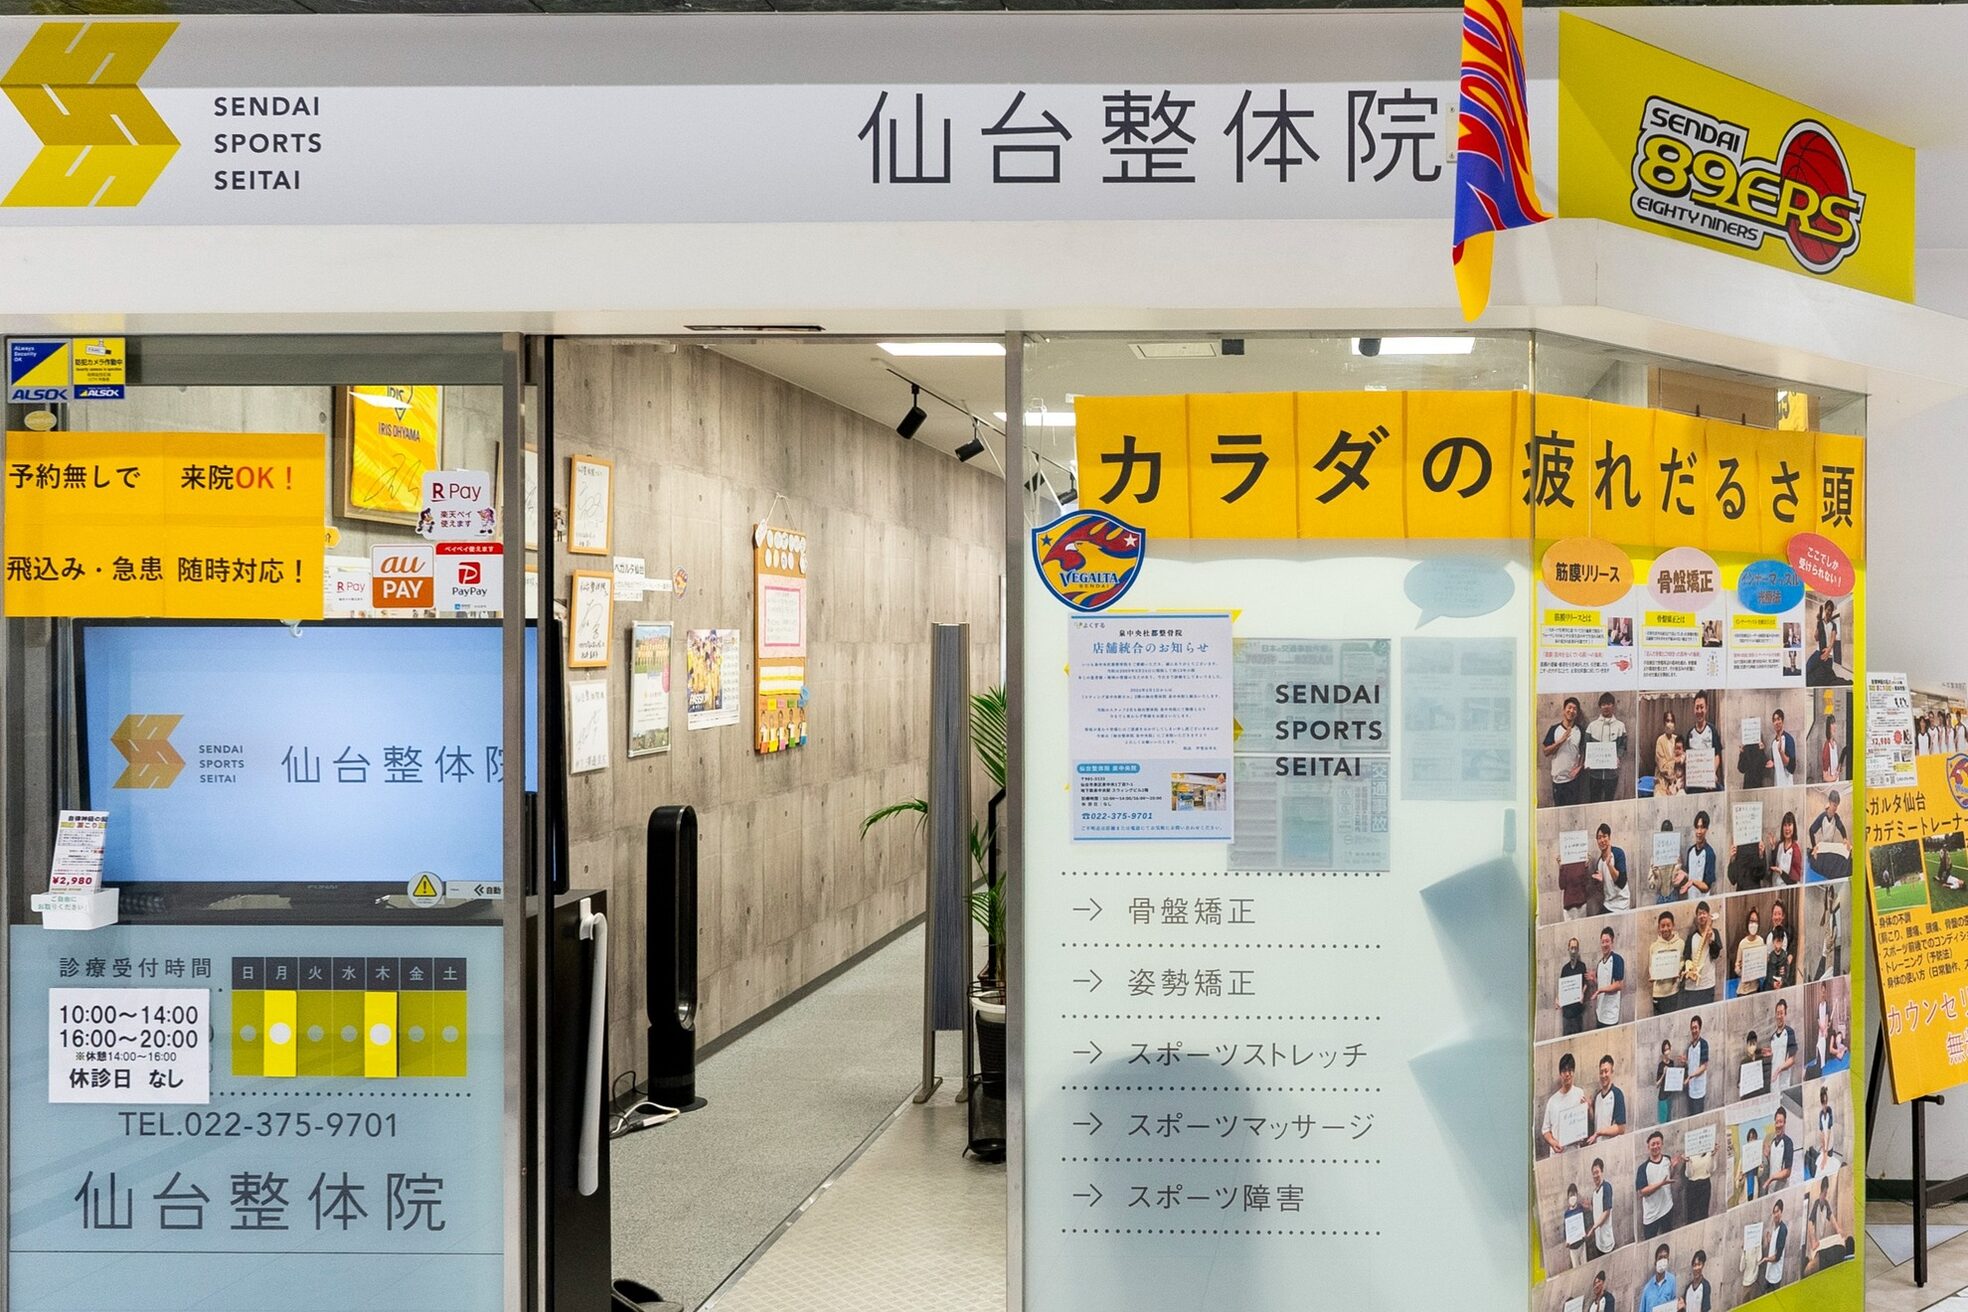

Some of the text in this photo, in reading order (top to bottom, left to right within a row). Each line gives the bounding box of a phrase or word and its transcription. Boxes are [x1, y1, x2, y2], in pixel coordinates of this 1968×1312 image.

[213, 96, 321, 117] SENDAI
[858, 90, 1443, 184] 仙台整体院
[1650, 107, 1741, 153] SENDAI
[213, 133, 323, 154] SPORTS
[213, 170, 301, 191] SEITAI
[1639, 135, 1861, 248] 89ERS
[1637, 196, 1760, 242] EIGHTY NINERS
[12, 388, 68, 401] ALSOK
[87, 389, 120, 397] ALSOK
[378, 422, 421, 442] IRIS OHYAMA
[9, 463, 141, 489] 予約無しで
[1100, 424, 1855, 528] カラダの疲れだるさ頭
[431, 482, 482, 502] R Pay
[440, 510, 472, 518] 楽天ペイ
[440, 519, 472, 528] 使えます
[380, 555, 426, 575] au
[1806, 546, 1839, 571] ここでしか
[6, 555, 164, 583] 飛込み・急患
[177, 556, 303, 584] 随時対応！
[1059, 569, 1120, 587] VEGALTA
[1555, 561, 1621, 583] 筋膜リリース
[1798, 557, 1842, 588] 受けられない！
[346, 582, 366, 592] Pay
[383, 580, 424, 599] PAY
[452, 586, 488, 597] PayPay
[1657, 569, 1714, 595] 骨盤矯正
[1092, 641, 1209, 654] 店舗統合のお知らせ
[1275, 684, 1380, 704] SENDAI
[1275, 720, 1382, 740] SPORTS
[199, 745, 244, 754] SENDAI
[199, 759, 245, 769] SPORTS
[1275, 756, 1361, 777] SEITAI
[199, 773, 237, 783] SEITAI
[1866, 791, 1926, 816] ガルタ仙台
[52, 876, 93, 885] ¥2,980
[1127, 896, 1256, 926] 骨盤矯正
[59, 957, 212, 978] 診療受付時間
[242, 966, 457, 980] 日 月 火 水 木 金 土
[1127, 967, 1256, 997] 姿勢矯正
[1127, 1040, 1368, 1069] スポーツストレッチ
[69, 1069, 184, 1089] 休診日 なし
[119, 1112, 398, 1138] TEL.022-375-9701
[1127, 1112, 1375, 1140] スポーツマッサージ
[74, 1170, 446, 1232] 仙台整体院
[1127, 1183, 1304, 1212] スポーツ障害
